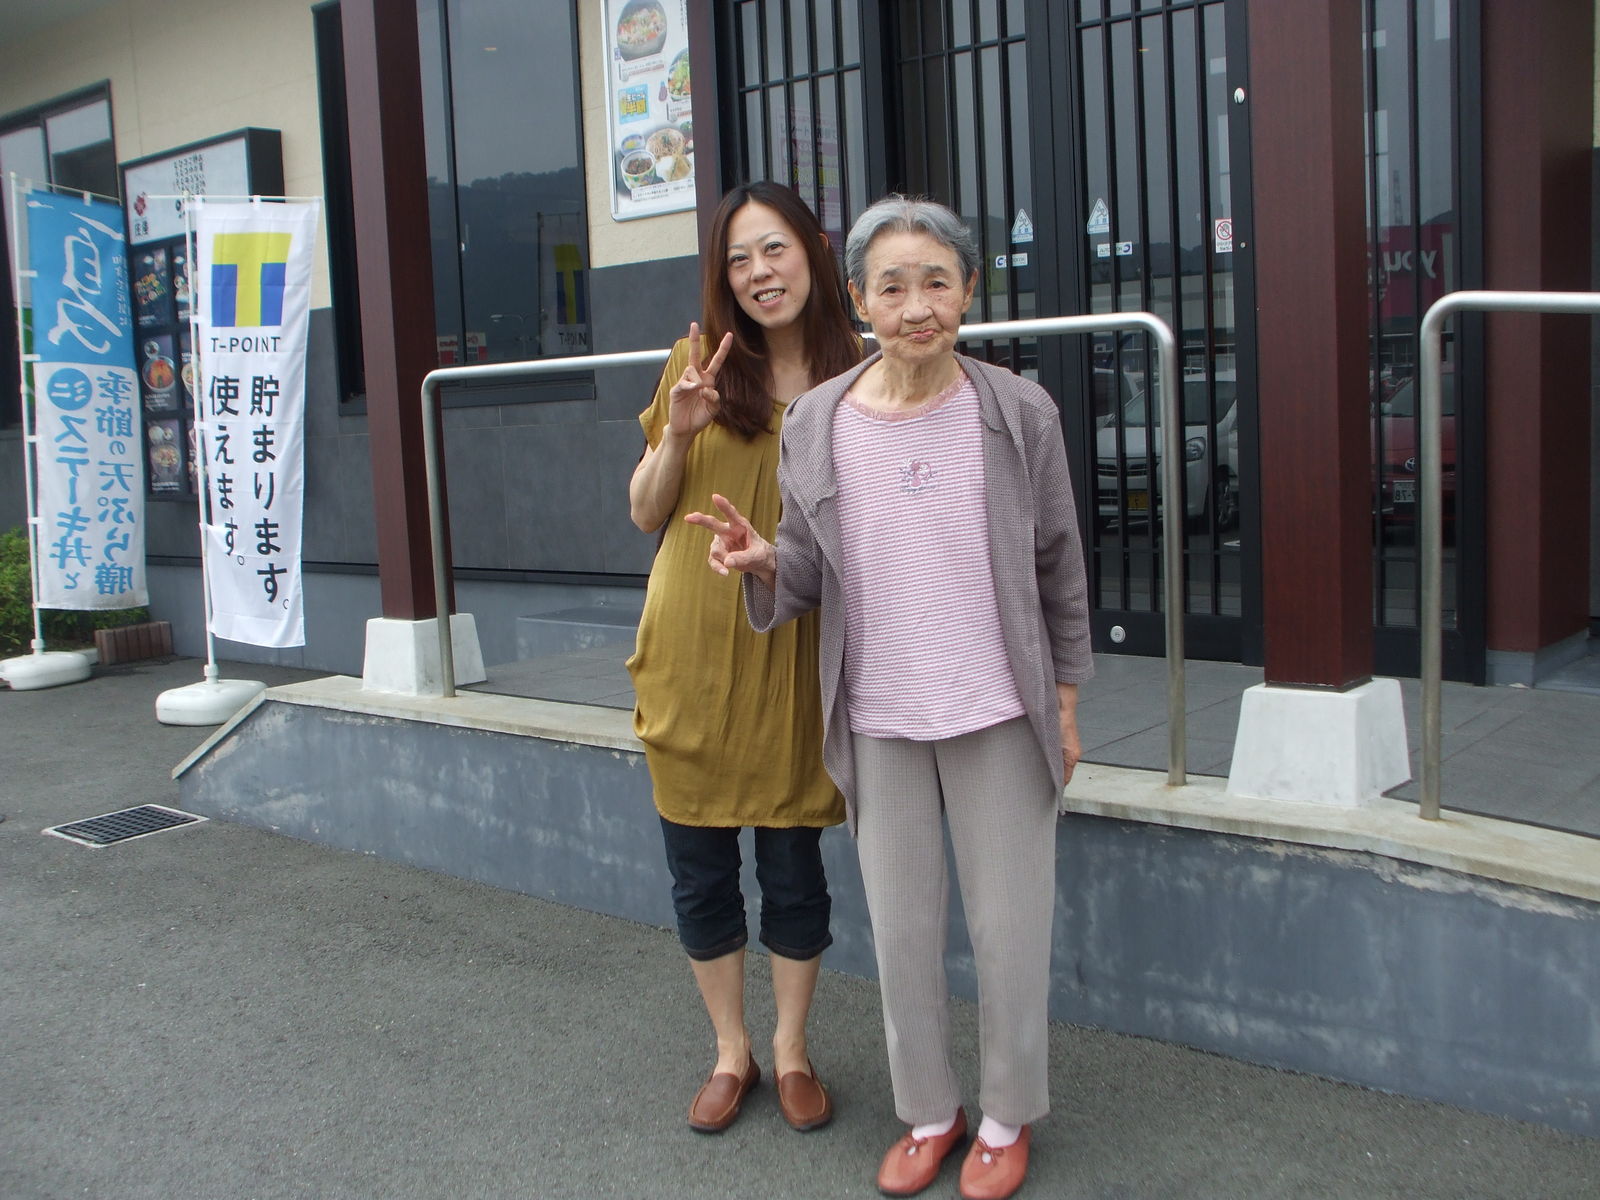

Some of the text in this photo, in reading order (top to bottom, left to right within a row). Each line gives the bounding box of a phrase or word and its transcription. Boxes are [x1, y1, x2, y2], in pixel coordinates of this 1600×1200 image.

[210, 336, 281, 352] T-POINT
[208, 375, 245, 566] 使えます。
[248, 374, 290, 610] 貯まります。
